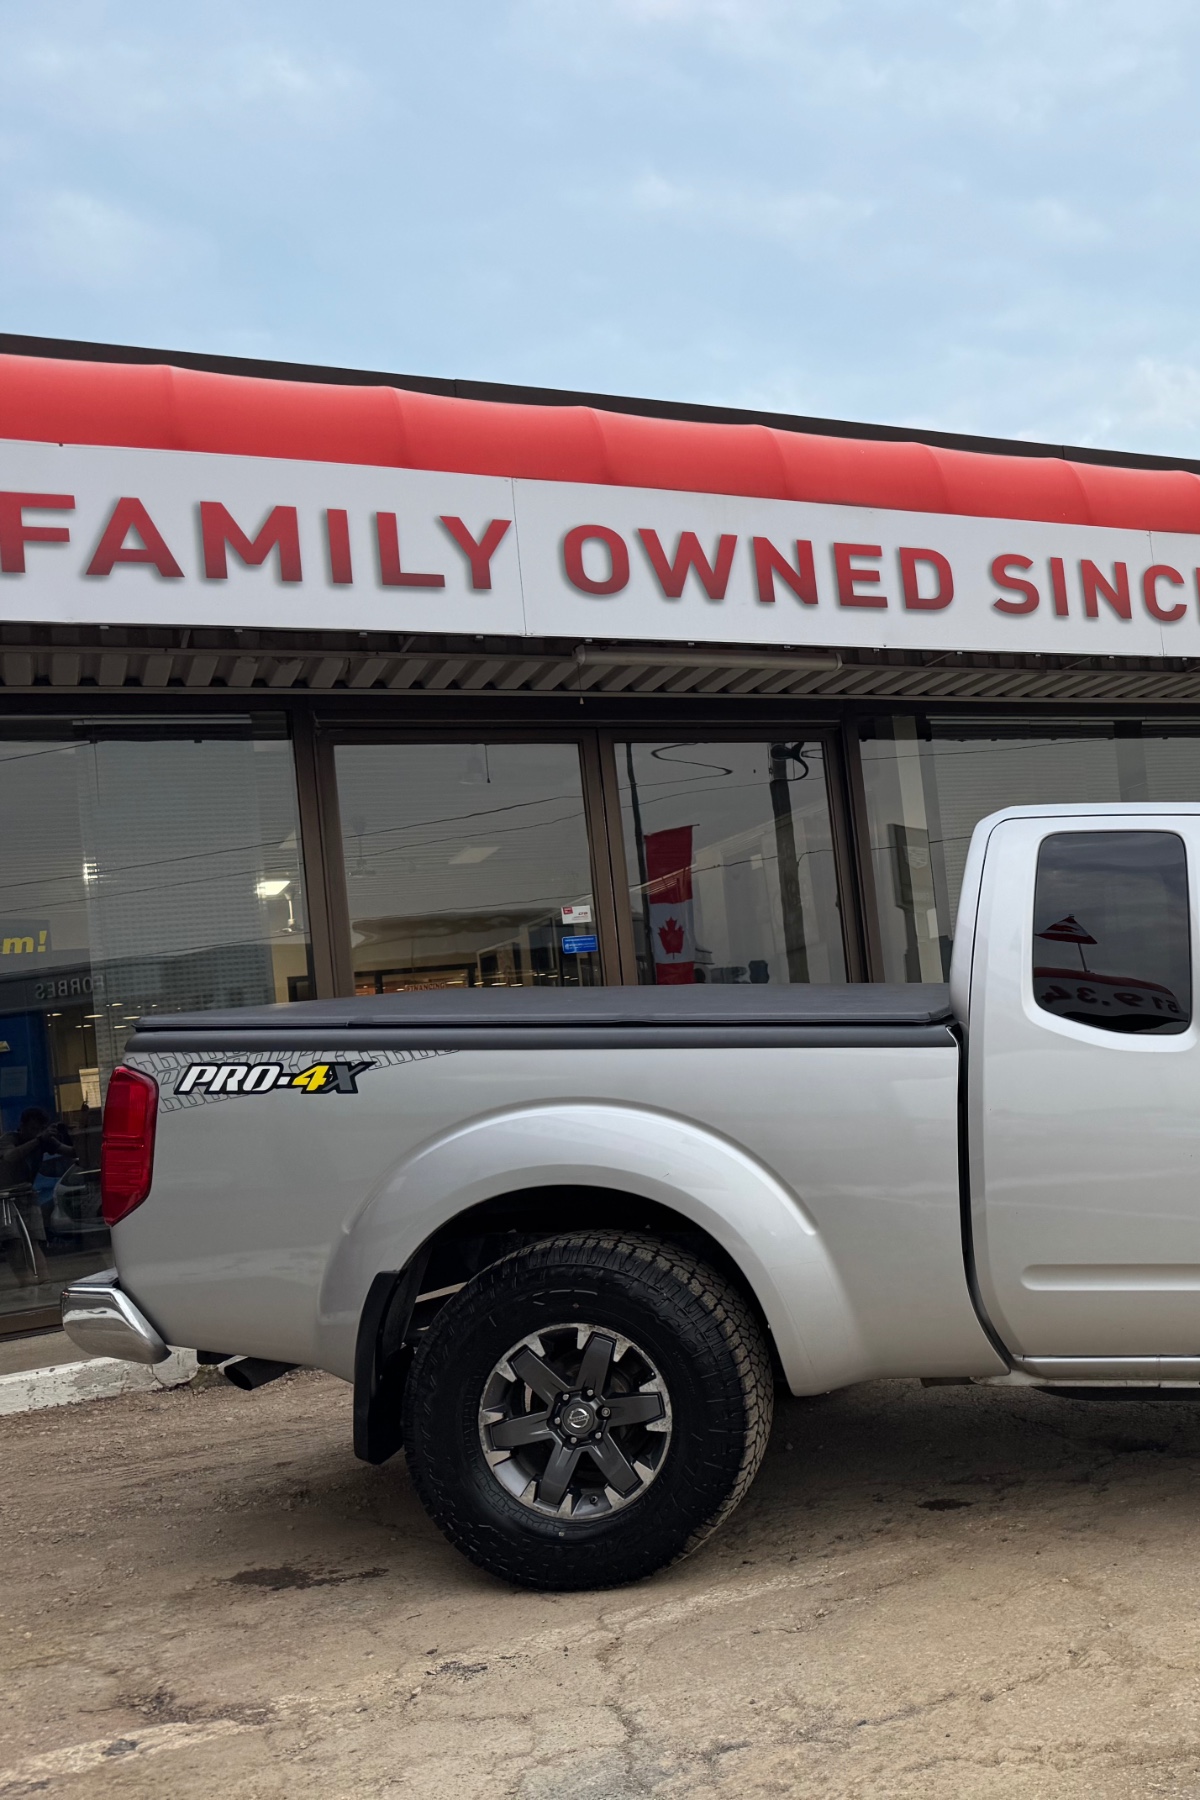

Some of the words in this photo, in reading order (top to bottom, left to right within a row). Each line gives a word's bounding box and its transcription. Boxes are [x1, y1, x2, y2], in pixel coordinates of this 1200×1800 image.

[0, 491, 512, 590] FAMILY
[562, 523, 954, 611] OWNED
[176, 1062, 376, 1094] PRO-4X
